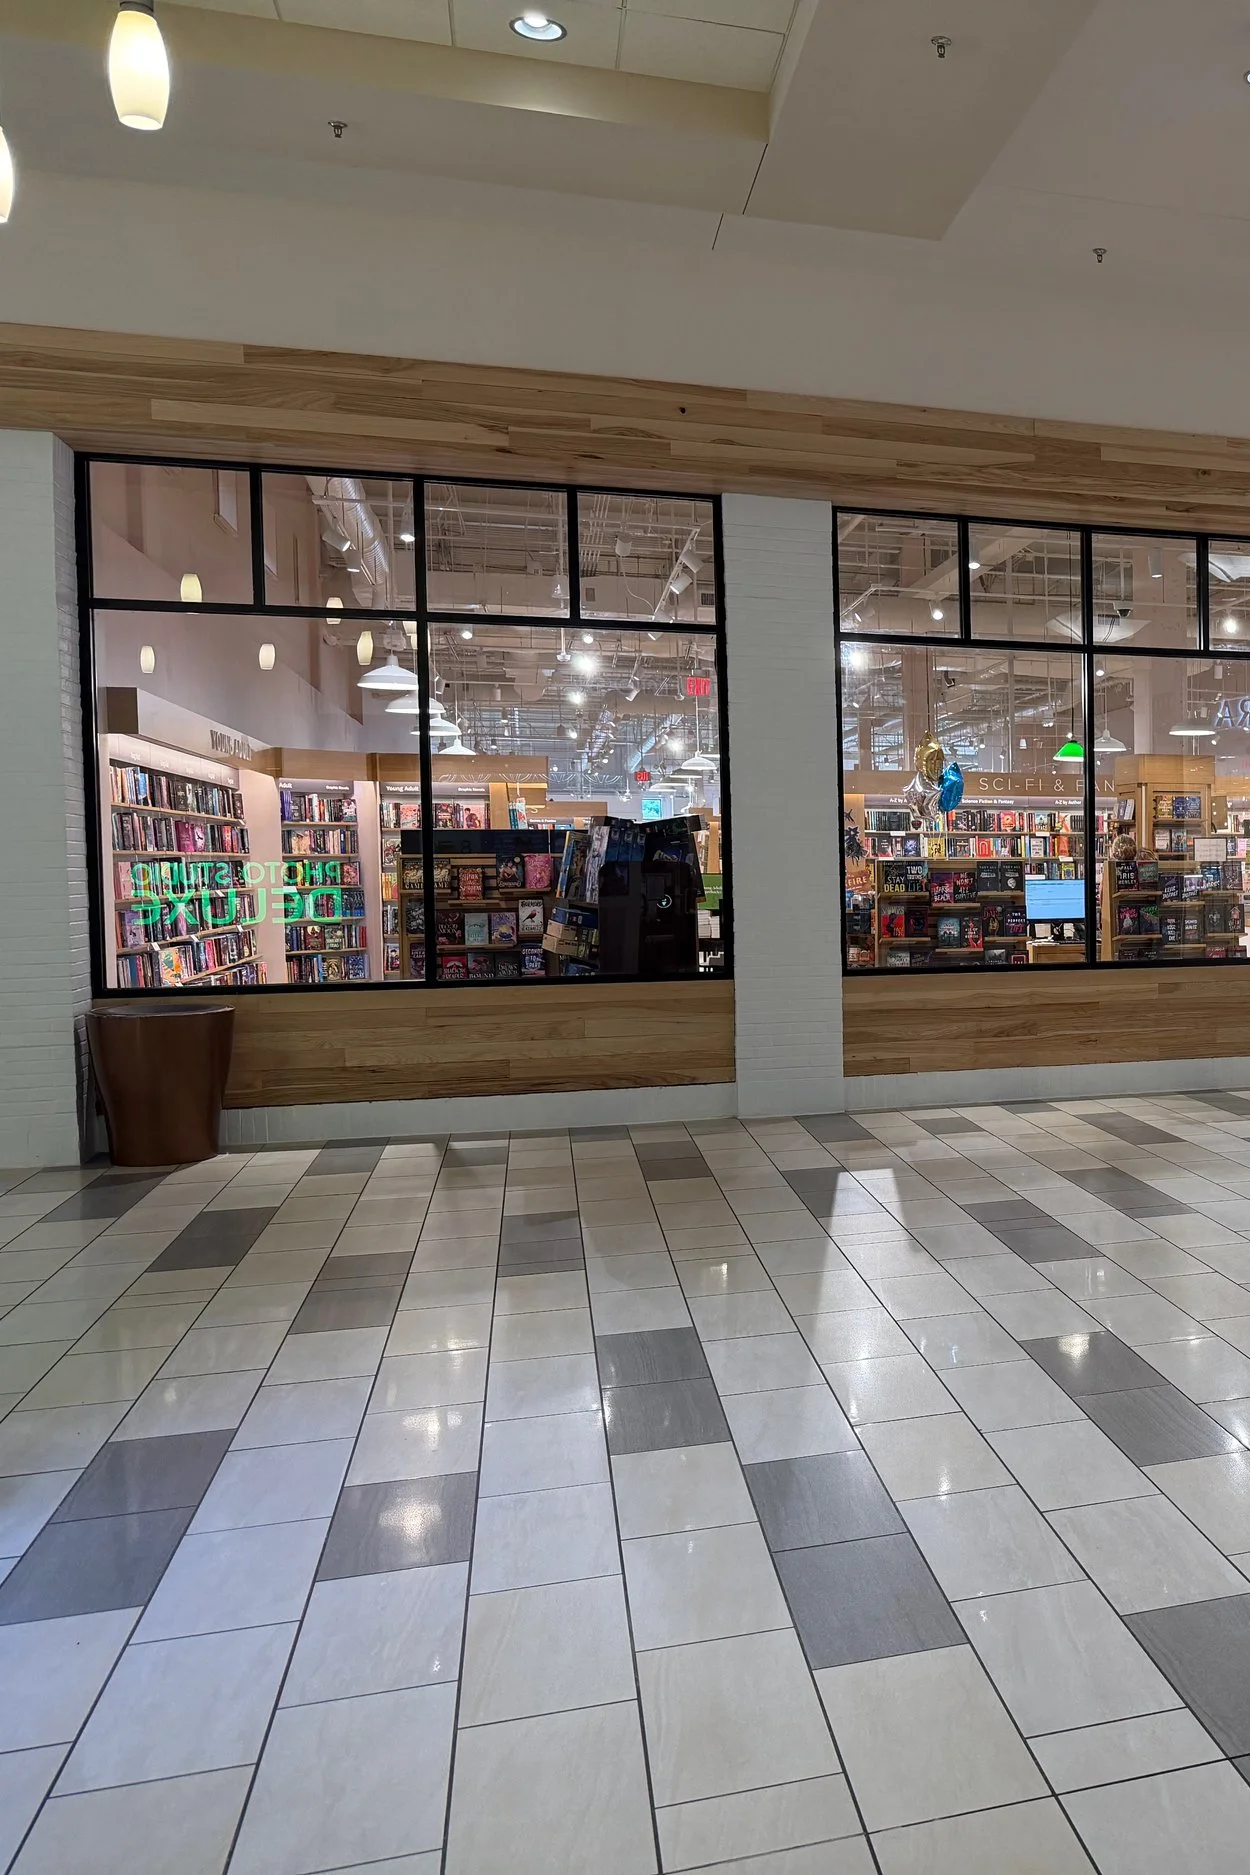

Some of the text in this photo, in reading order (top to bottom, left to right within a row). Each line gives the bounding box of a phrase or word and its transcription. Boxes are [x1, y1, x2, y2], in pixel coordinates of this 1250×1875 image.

[687, 677, 710, 696] EXIT
[404, 784, 419, 792] Adult
[979, 777, 1043, 792] SCI-FI
[1053, 778, 1065, 792] &
[998, 798, 1015, 806] Fantasy
[906, 865, 923, 874] TWO
[886, 876, 905, 885] STAY
[884, 883, 905, 893] DEAD
